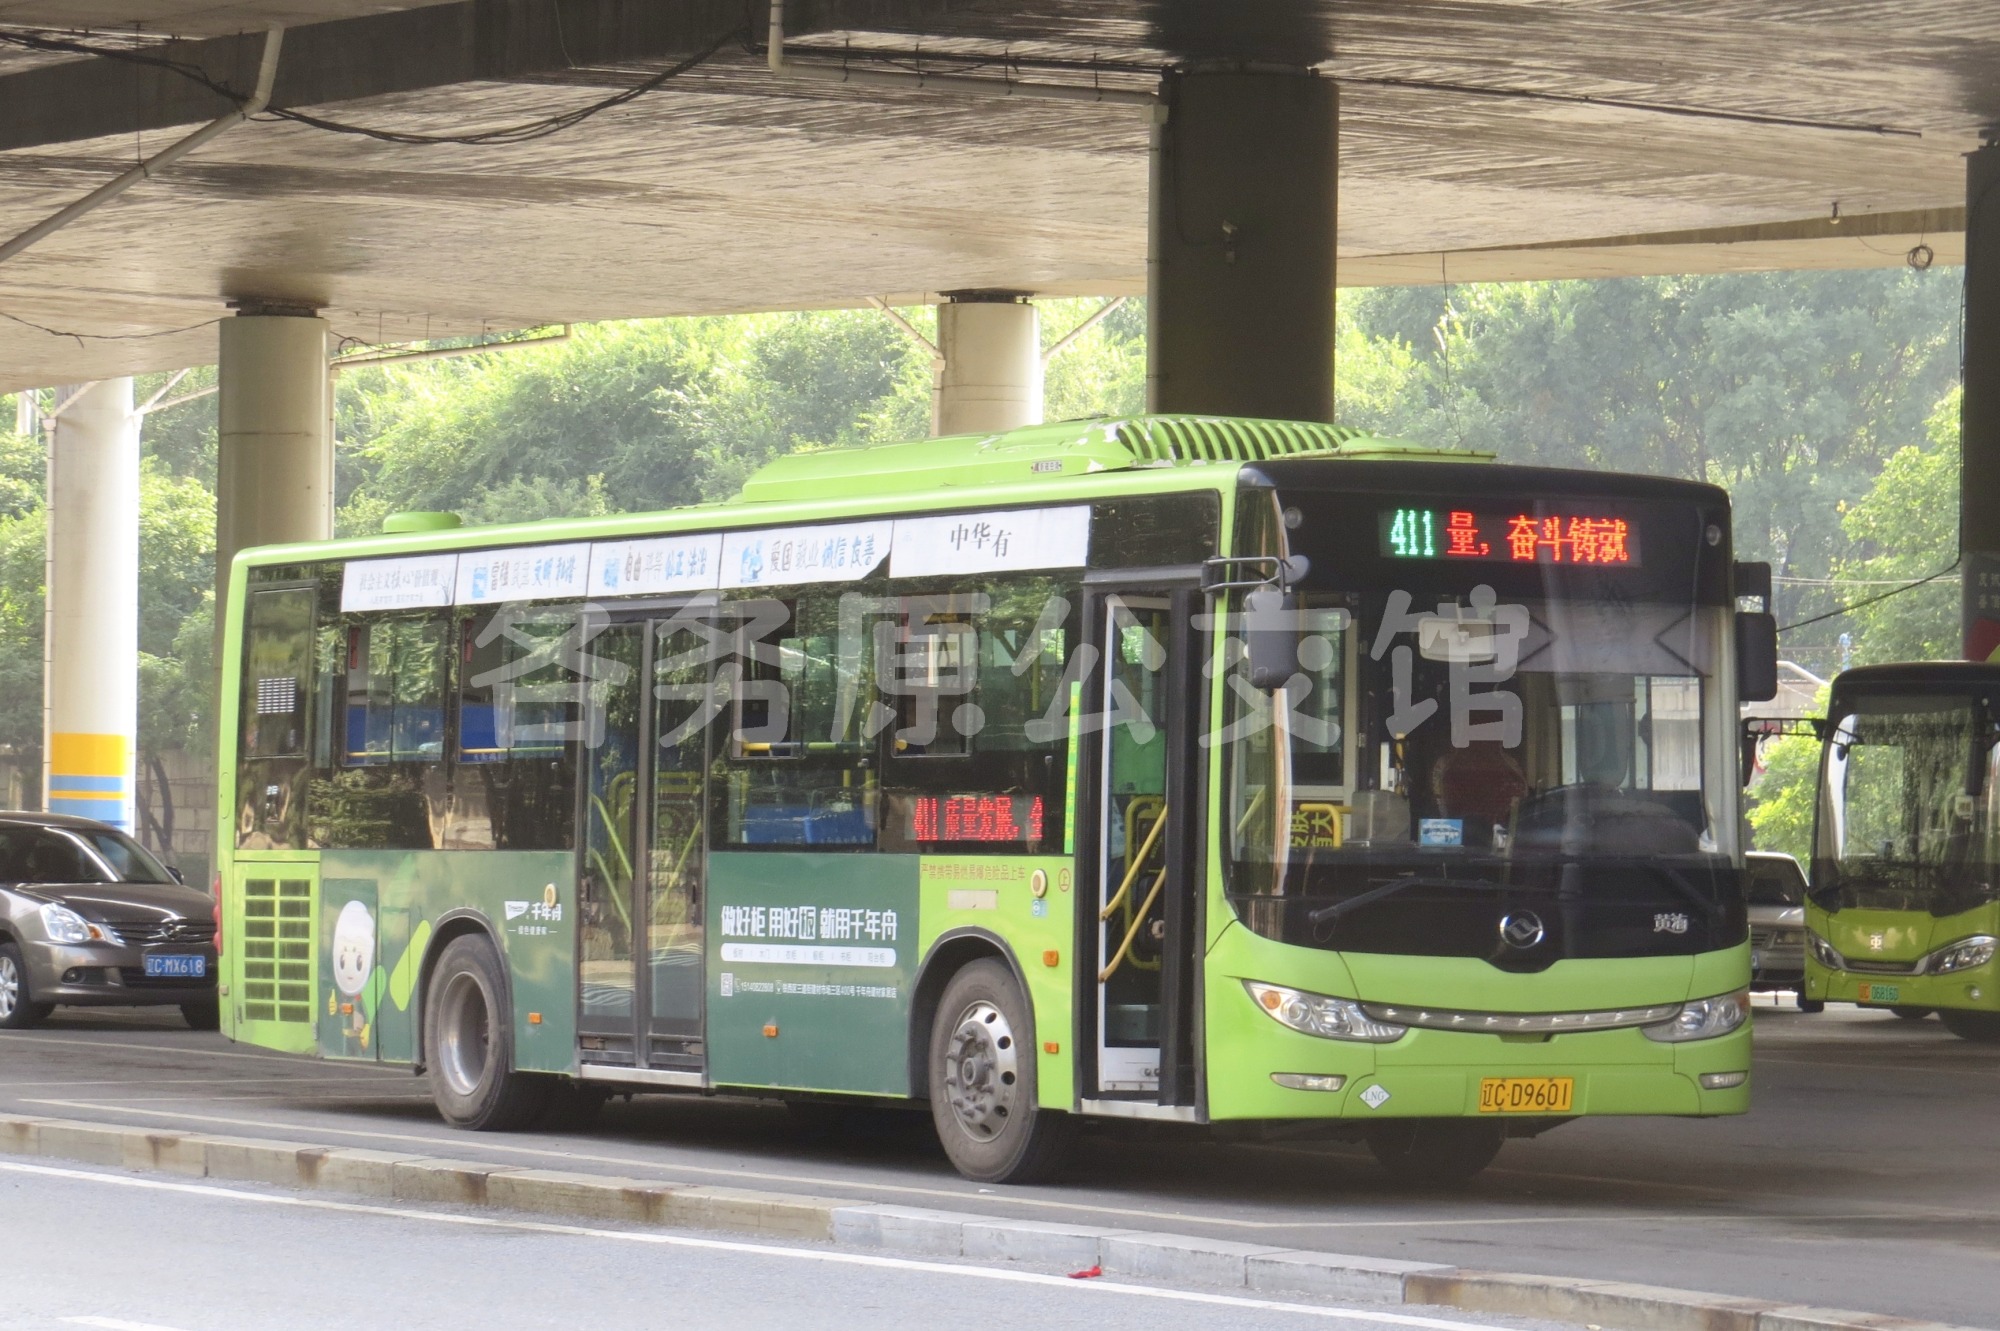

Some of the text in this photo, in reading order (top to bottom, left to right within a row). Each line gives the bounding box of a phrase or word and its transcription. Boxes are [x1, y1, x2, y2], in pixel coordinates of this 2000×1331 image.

[949, 521, 1013, 558] 中华有
[1390, 509, 1435, 556] 411
[913, 797, 938, 841] 411
[720, 905, 766, 937] 做好柜
[819, 907, 898, 941] 就用千年舟
[1653, 913, 1689, 934] 黄海
[1364, 1090, 1386, 1102] LNG
